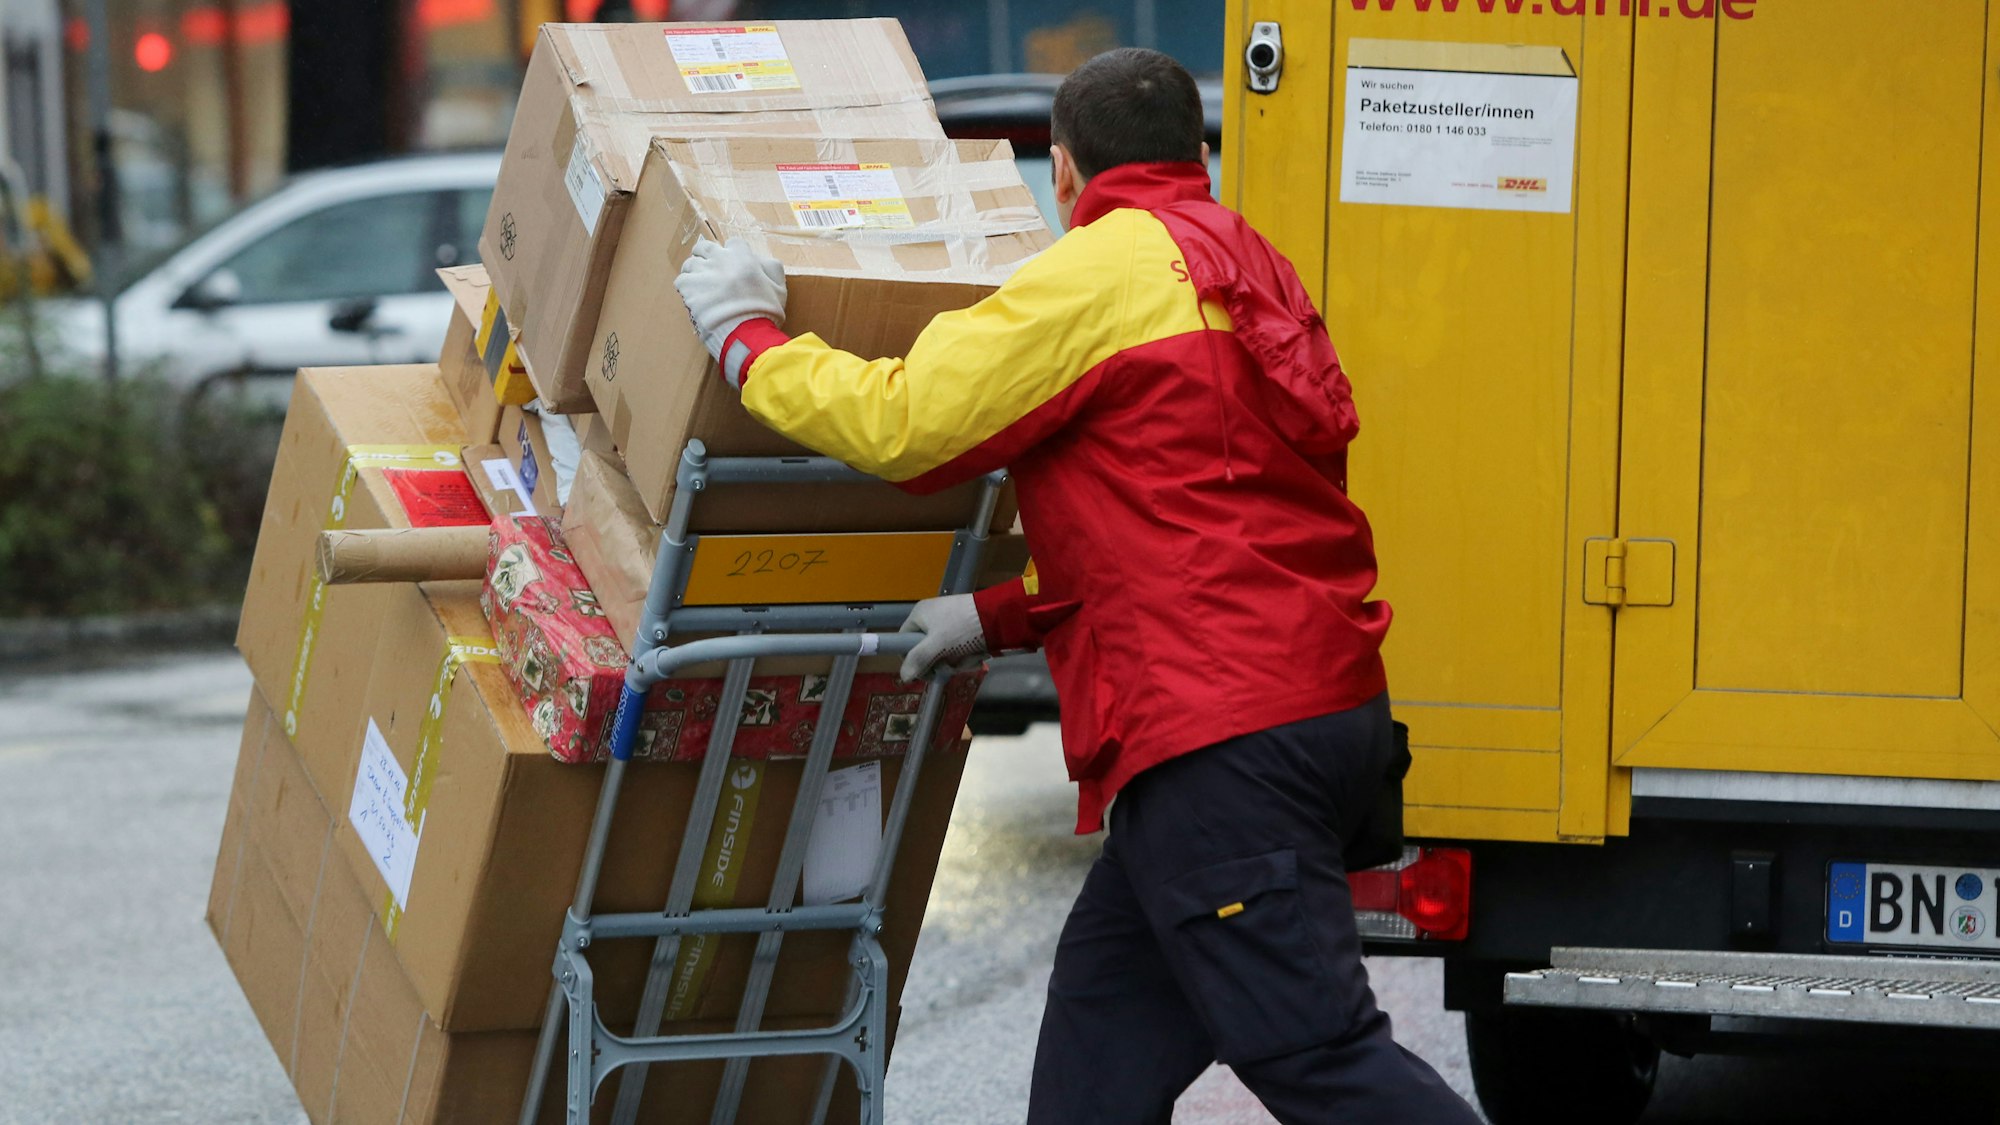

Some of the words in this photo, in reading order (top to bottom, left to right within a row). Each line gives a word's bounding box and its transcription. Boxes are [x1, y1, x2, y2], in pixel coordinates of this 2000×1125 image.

[1360, 80, 1376, 89] Wir
[1380, 81, 1414, 91] suchen
[1360, 98, 1534, 119] Paketzusteller/innen
[1359, 121, 1403, 133] Telefon:
[1406, 123, 1432, 134] 0180
[1436, 125, 1441, 134] 1
[1446, 125, 1464, 135] 146
[1467, 126, 1487, 136] 033
[1503, 178, 1540, 190] DHL
[726, 549, 829, 577] 2207
[712, 794, 744, 887] FINSIDE
[1839, 910, 1852, 928] D
[1870, 871, 1946, 936] BN
